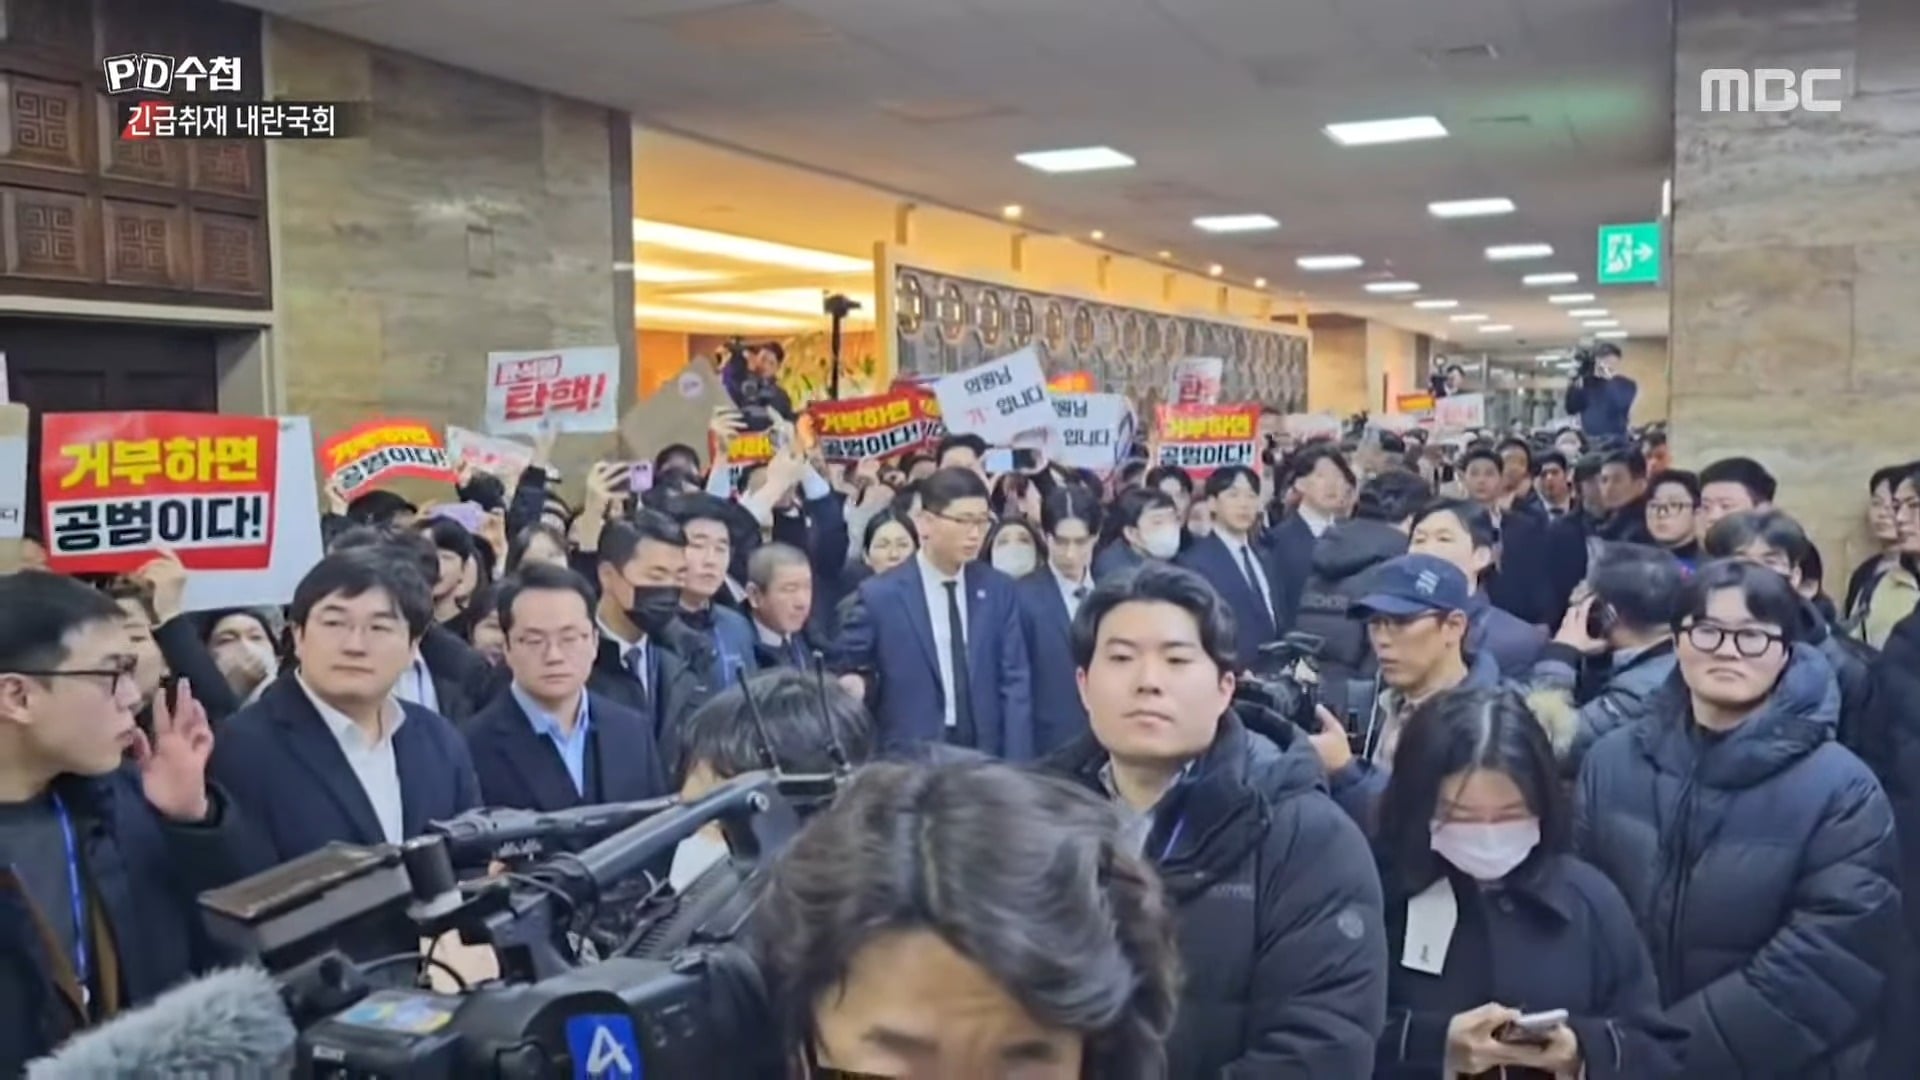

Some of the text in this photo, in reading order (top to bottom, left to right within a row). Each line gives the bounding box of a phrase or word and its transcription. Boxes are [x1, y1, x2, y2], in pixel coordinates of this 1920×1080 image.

[505, 373, 607, 420] 탄핵!
[964, 365, 1013, 396] 의원님
[823, 399, 911, 433] 거부하면
[996, 385, 1044, 416] 입니다
[823, 422, 919, 457] 공범이다!
[1063, 429, 1110, 447] 입니다
[1161, 444, 1252, 466] 공범이다!
[60, 436, 258, 489] 거부하면
[340, 447, 447, 490] 공범이다!
[54, 496, 262, 552] 공범이다!
